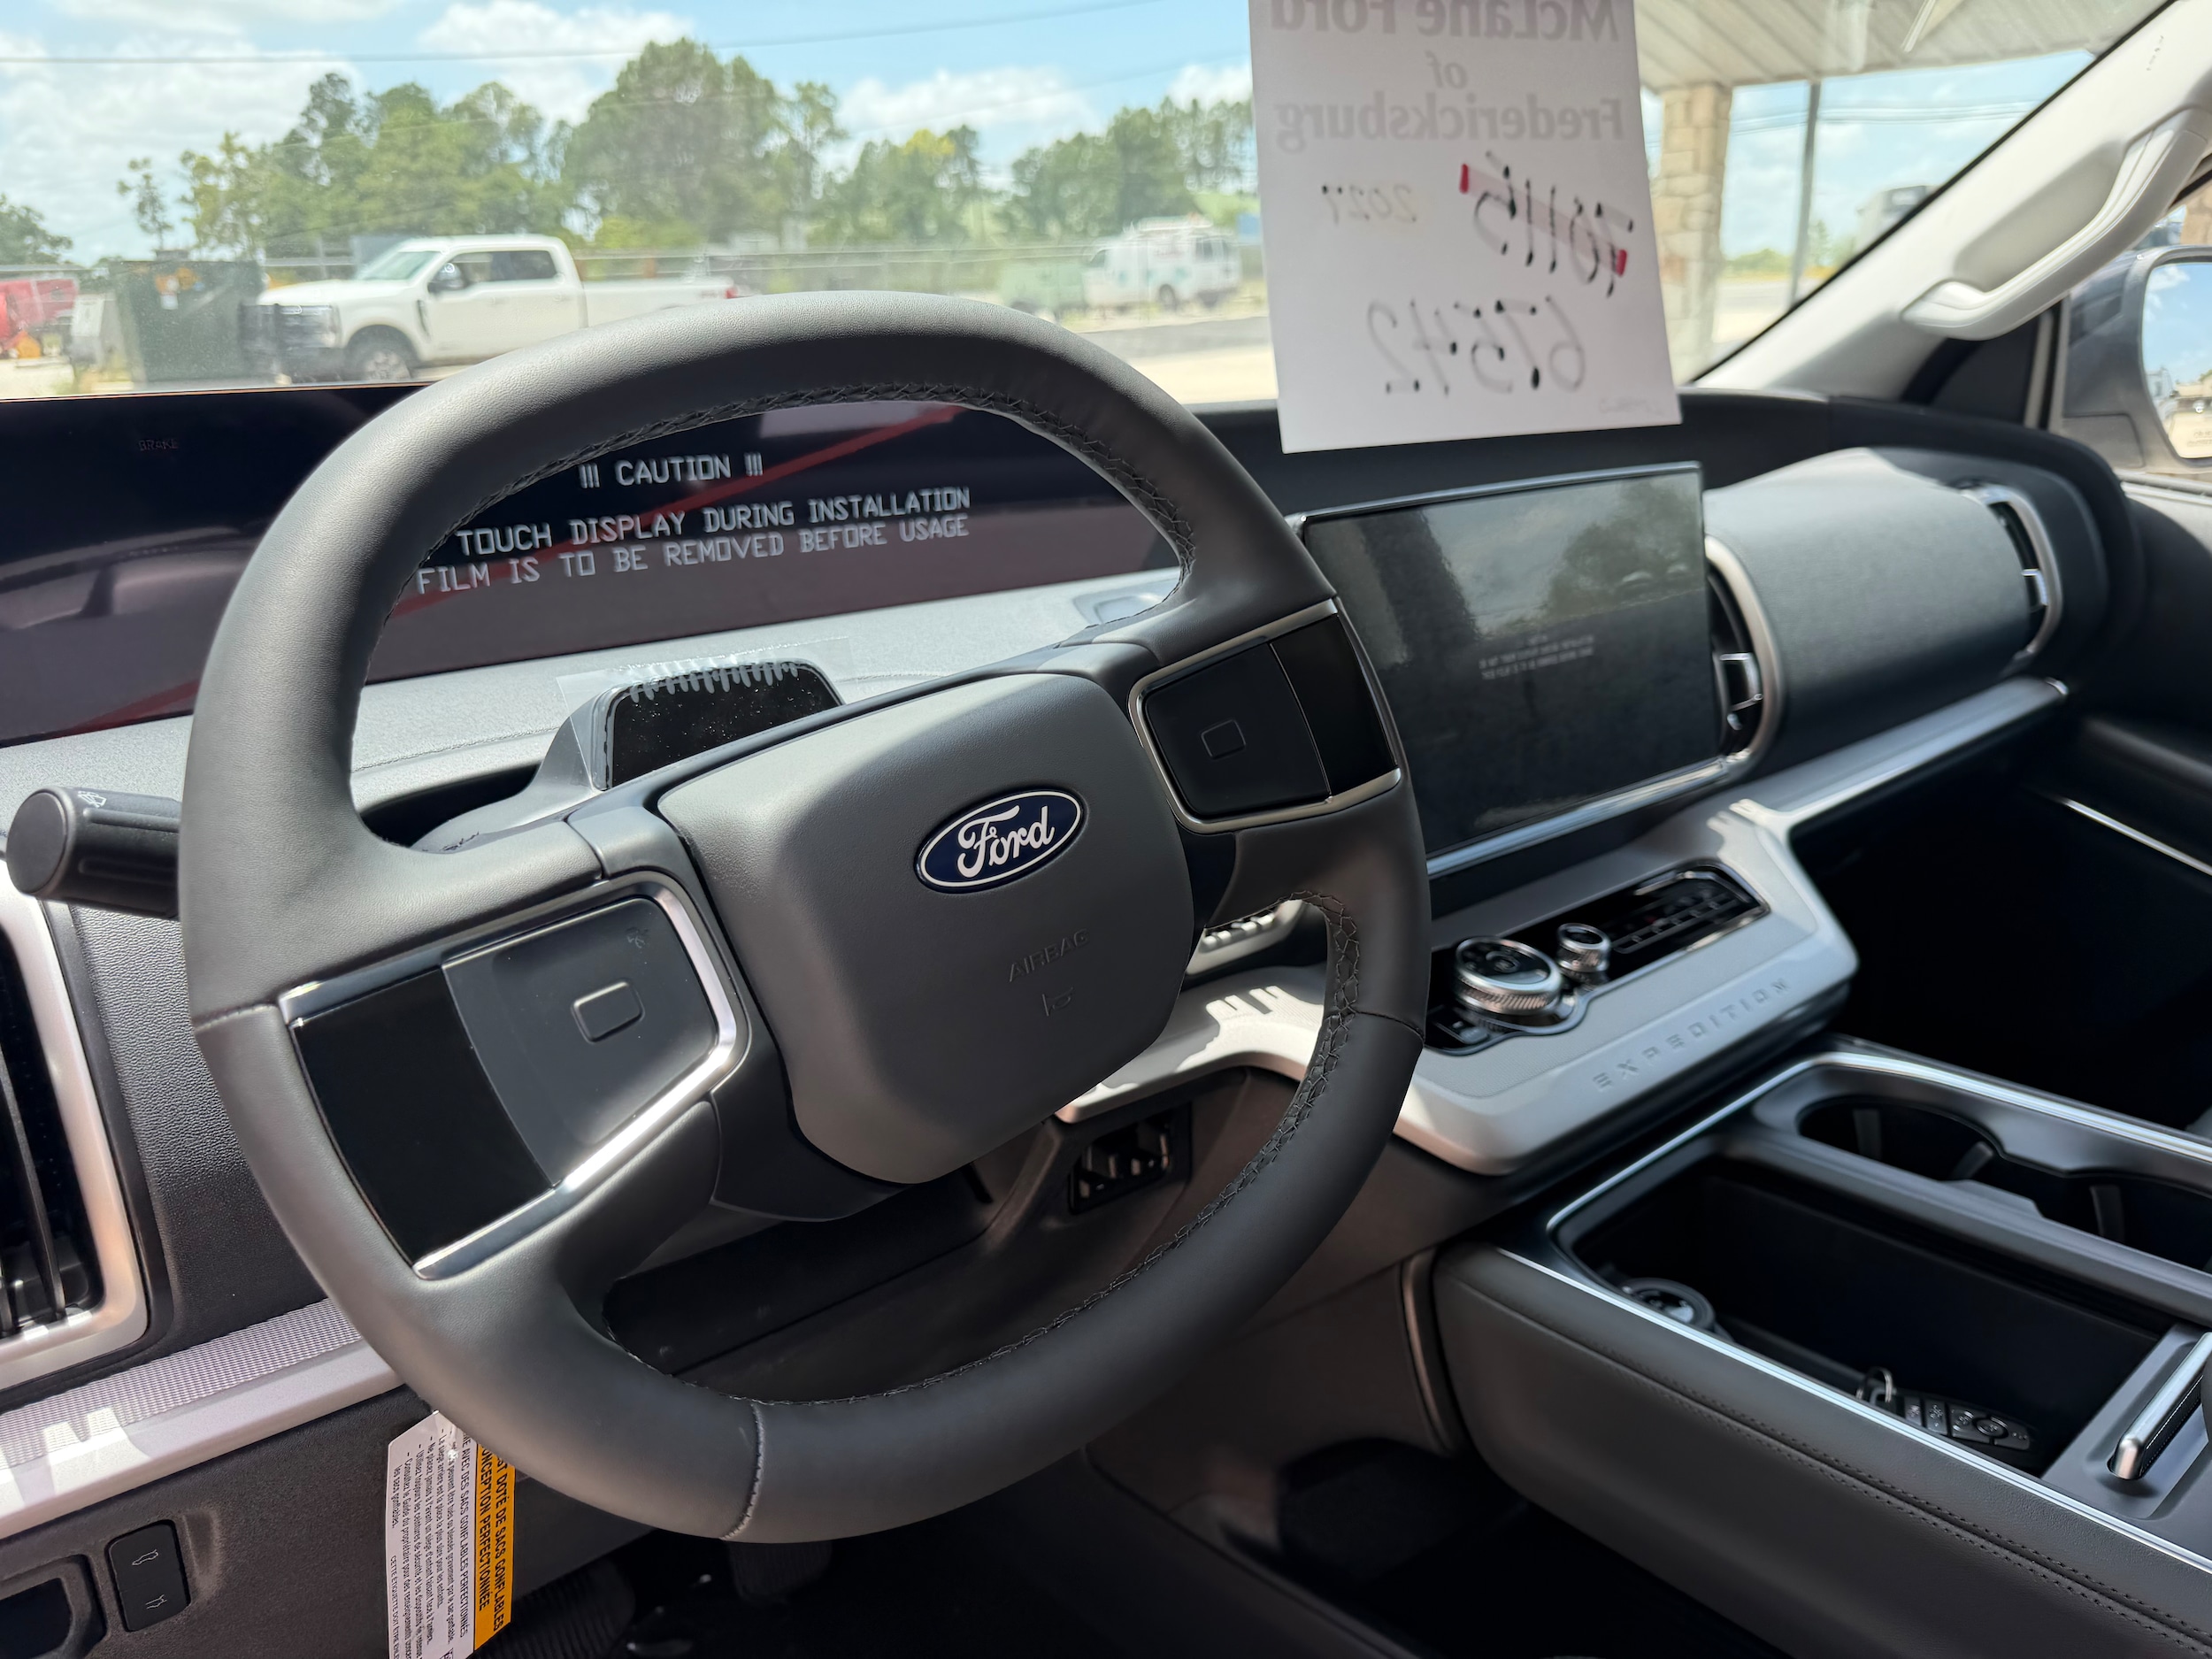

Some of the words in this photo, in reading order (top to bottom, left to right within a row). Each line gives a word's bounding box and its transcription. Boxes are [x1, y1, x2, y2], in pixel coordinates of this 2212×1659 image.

[615, 453, 732, 487] CAUTION
[455, 522, 552, 557] TOUCH
[568, 511, 686, 546] DISPLAY
[703, 501, 795, 533] DURING
[808, 487, 971, 524] INSTALLATION
[416, 562, 491, 595] FILM
[509, 557, 541, 584] IS
[558, 549, 596, 578] TO
[612, 544, 649, 572] BE
[664, 532, 785, 566] REMOVED
[799, 520, 887, 553] BEFORE
[899, 512, 971, 542] USAGE
[956, 805, 1056, 879] Ford
[1008, 929, 1090, 983] AIRBAG
[1591, 977, 1791, 1092] EXPEDITION
[460, 1471, 469, 1491] DES
[461, 1448, 471, 1471] AVEC
[480, 1447, 492, 1516] ONCEPTION
[497, 1458, 508, 1473] ST
[460, 1490, 469, 1515] SACS
[495, 1508, 506, 1527] DE
[460, 1515, 469, 1571] GONFLABLES
[495, 1527, 506, 1559] SACS
[494, 1559, 506, 1632] GONFLABLES
